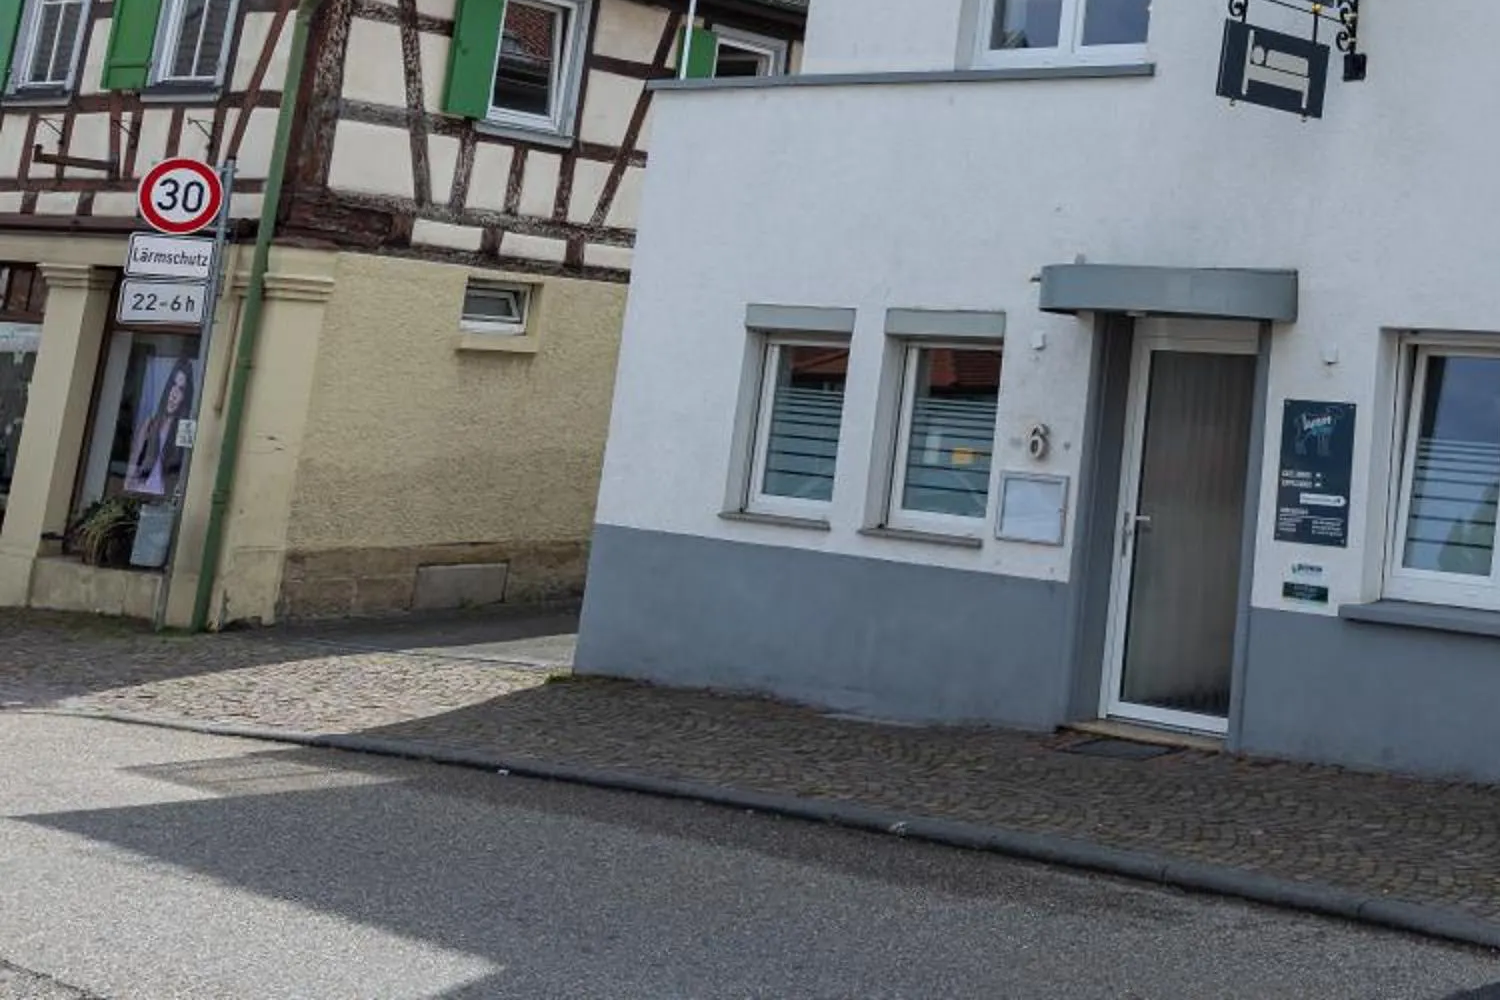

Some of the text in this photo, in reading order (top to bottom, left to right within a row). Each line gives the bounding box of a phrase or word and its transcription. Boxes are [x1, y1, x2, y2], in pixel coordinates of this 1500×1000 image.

[157, 178, 205, 213] 30
[132, 247, 209, 267] Lärmschutz
[131, 293, 196, 313] 22-6 h
[1028, 423, 1049, 460] 6
